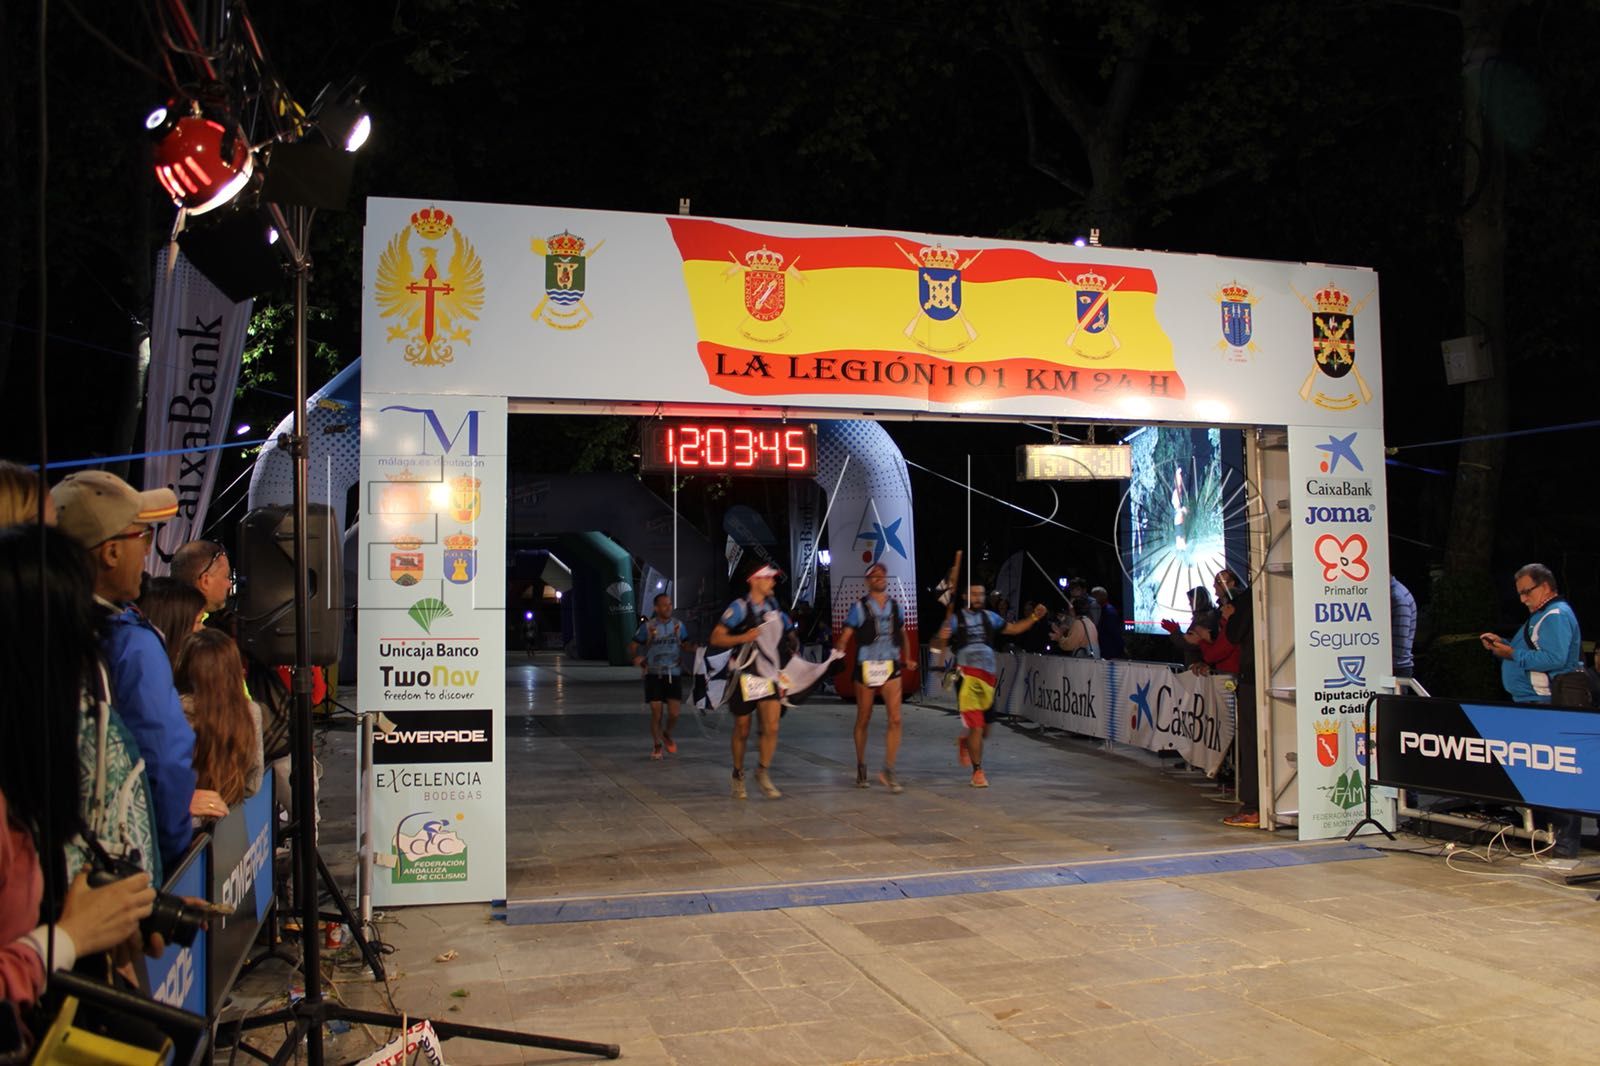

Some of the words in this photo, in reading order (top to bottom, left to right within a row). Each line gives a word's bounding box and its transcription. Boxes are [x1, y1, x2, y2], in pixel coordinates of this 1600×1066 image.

[715, 353, 777, 378] LA
[1024, 368, 1085, 392] KM
[1149, 375, 1169, 397] H
[667, 427, 806, 467] 12:03:45
[1306, 479, 1372, 497] CaixaBank
[1324, 586, 1369, 595] Primaflor
[1315, 602, 1373, 622] BBVA
[1309, 630, 1380, 650] Seguros
[379, 641, 434, 661] Unicaja
[436, 643, 479, 657] Banco
[379, 665, 480, 687] TwoNav
[384, 690, 421, 700] freedom
[425, 690, 436, 700] to
[439, 690, 475, 700] discover
[1032, 670, 1097, 719] CaixaBank
[1321, 705, 1336, 715] de
[1339, 704, 1371, 715] Cádi
[372, 730, 488, 744] POWERADE
[1400, 731, 1578, 775] POWERADE
[424, 791, 483, 801] BODEGAS
[1334, 786, 1364, 807] FAM
[403, 867, 447, 875] ANDALUZA
